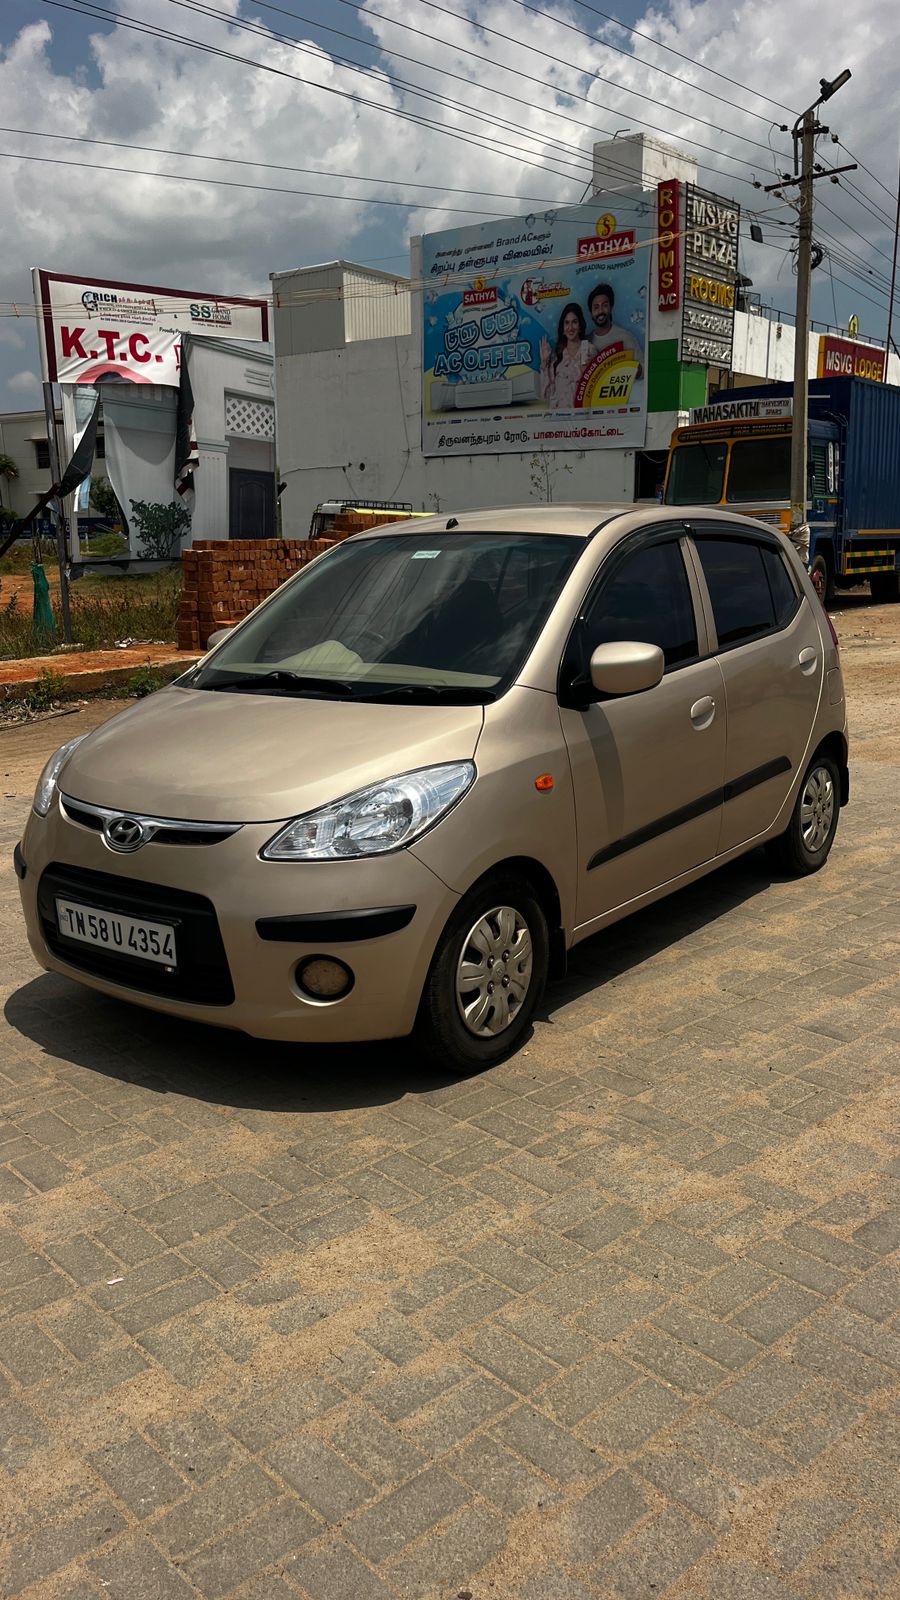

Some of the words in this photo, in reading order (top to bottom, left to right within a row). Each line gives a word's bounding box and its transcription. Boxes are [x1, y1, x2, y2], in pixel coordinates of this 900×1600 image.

[692, 198, 738, 237] MSVG
[496, 234, 519, 247] Brand
[580, 237, 630, 257] SATHYA
[659, 189, 674, 289] ROOMS
[693, 232, 736, 266] PLAZA
[430, 260, 455, 275] சிறப்பு
[457, 254, 499, 272] தள்ளுபடி
[92, 292, 118, 303] RICH
[464, 290, 496, 304] SATHYA
[658, 293, 677, 306] A/C
[690, 275, 735, 308] ROOMS
[190, 303, 211, 319] SS
[212, 313, 231, 321] HOME
[60, 326, 164, 363] K.T.C.
[434, 352, 463, 376] AC
[463, 341, 532, 370] OFFER
[826, 350, 852, 375] MSVG
[853, 358, 883, 383] LODGE
[577, 382, 587, 400] Cash
[583, 362, 597, 380] Back
[596, 347, 616, 363] Offers
[610, 375, 632, 384] EASY
[599, 385, 628, 398] EMI
[693, 401, 760, 425] MAHASAKTHI
[438, 431, 501, 448] திருவனந்தபுரம்
[533, 426, 624, 441] பாளையங்கோட்டை
